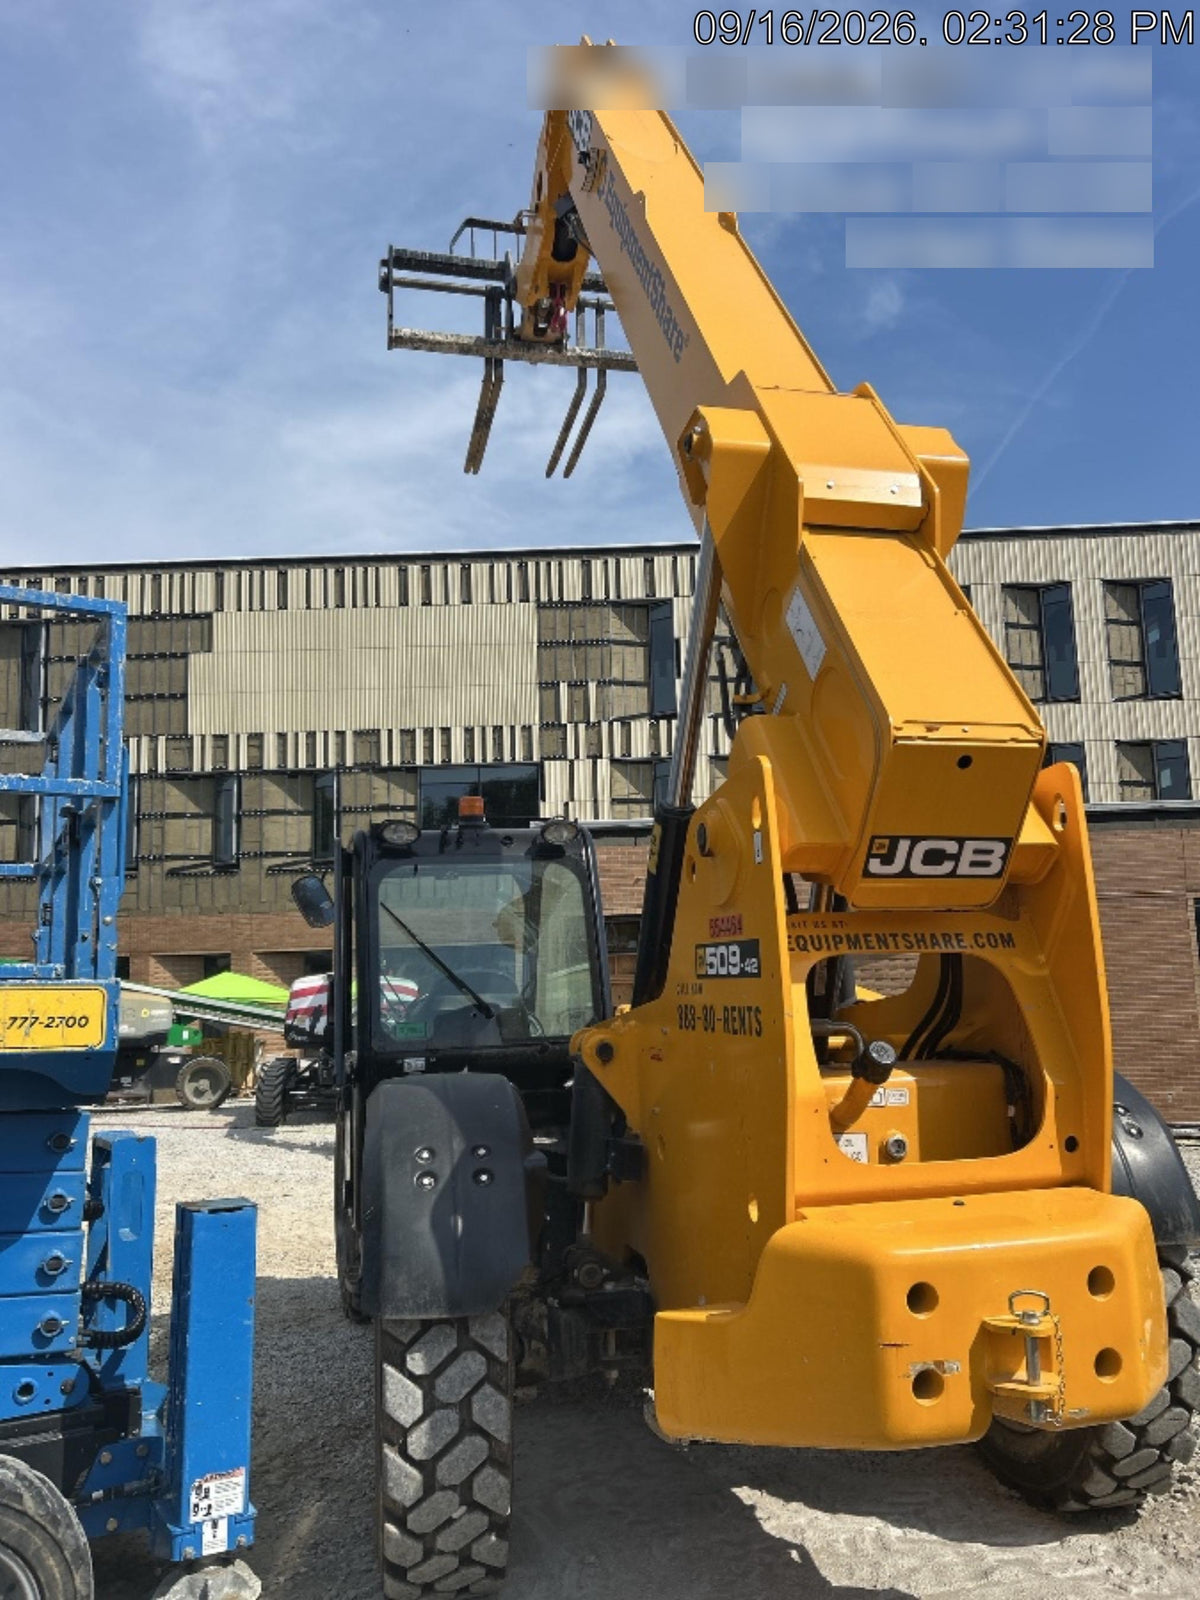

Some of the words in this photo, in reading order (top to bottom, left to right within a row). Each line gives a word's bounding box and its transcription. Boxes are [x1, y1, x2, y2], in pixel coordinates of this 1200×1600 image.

[868, 838, 1006, 876] JCB
[787, 932, 1016, 953] EQUIPMENTSHARE.COM
[6, 1015, 90, 1030] 777-2700
